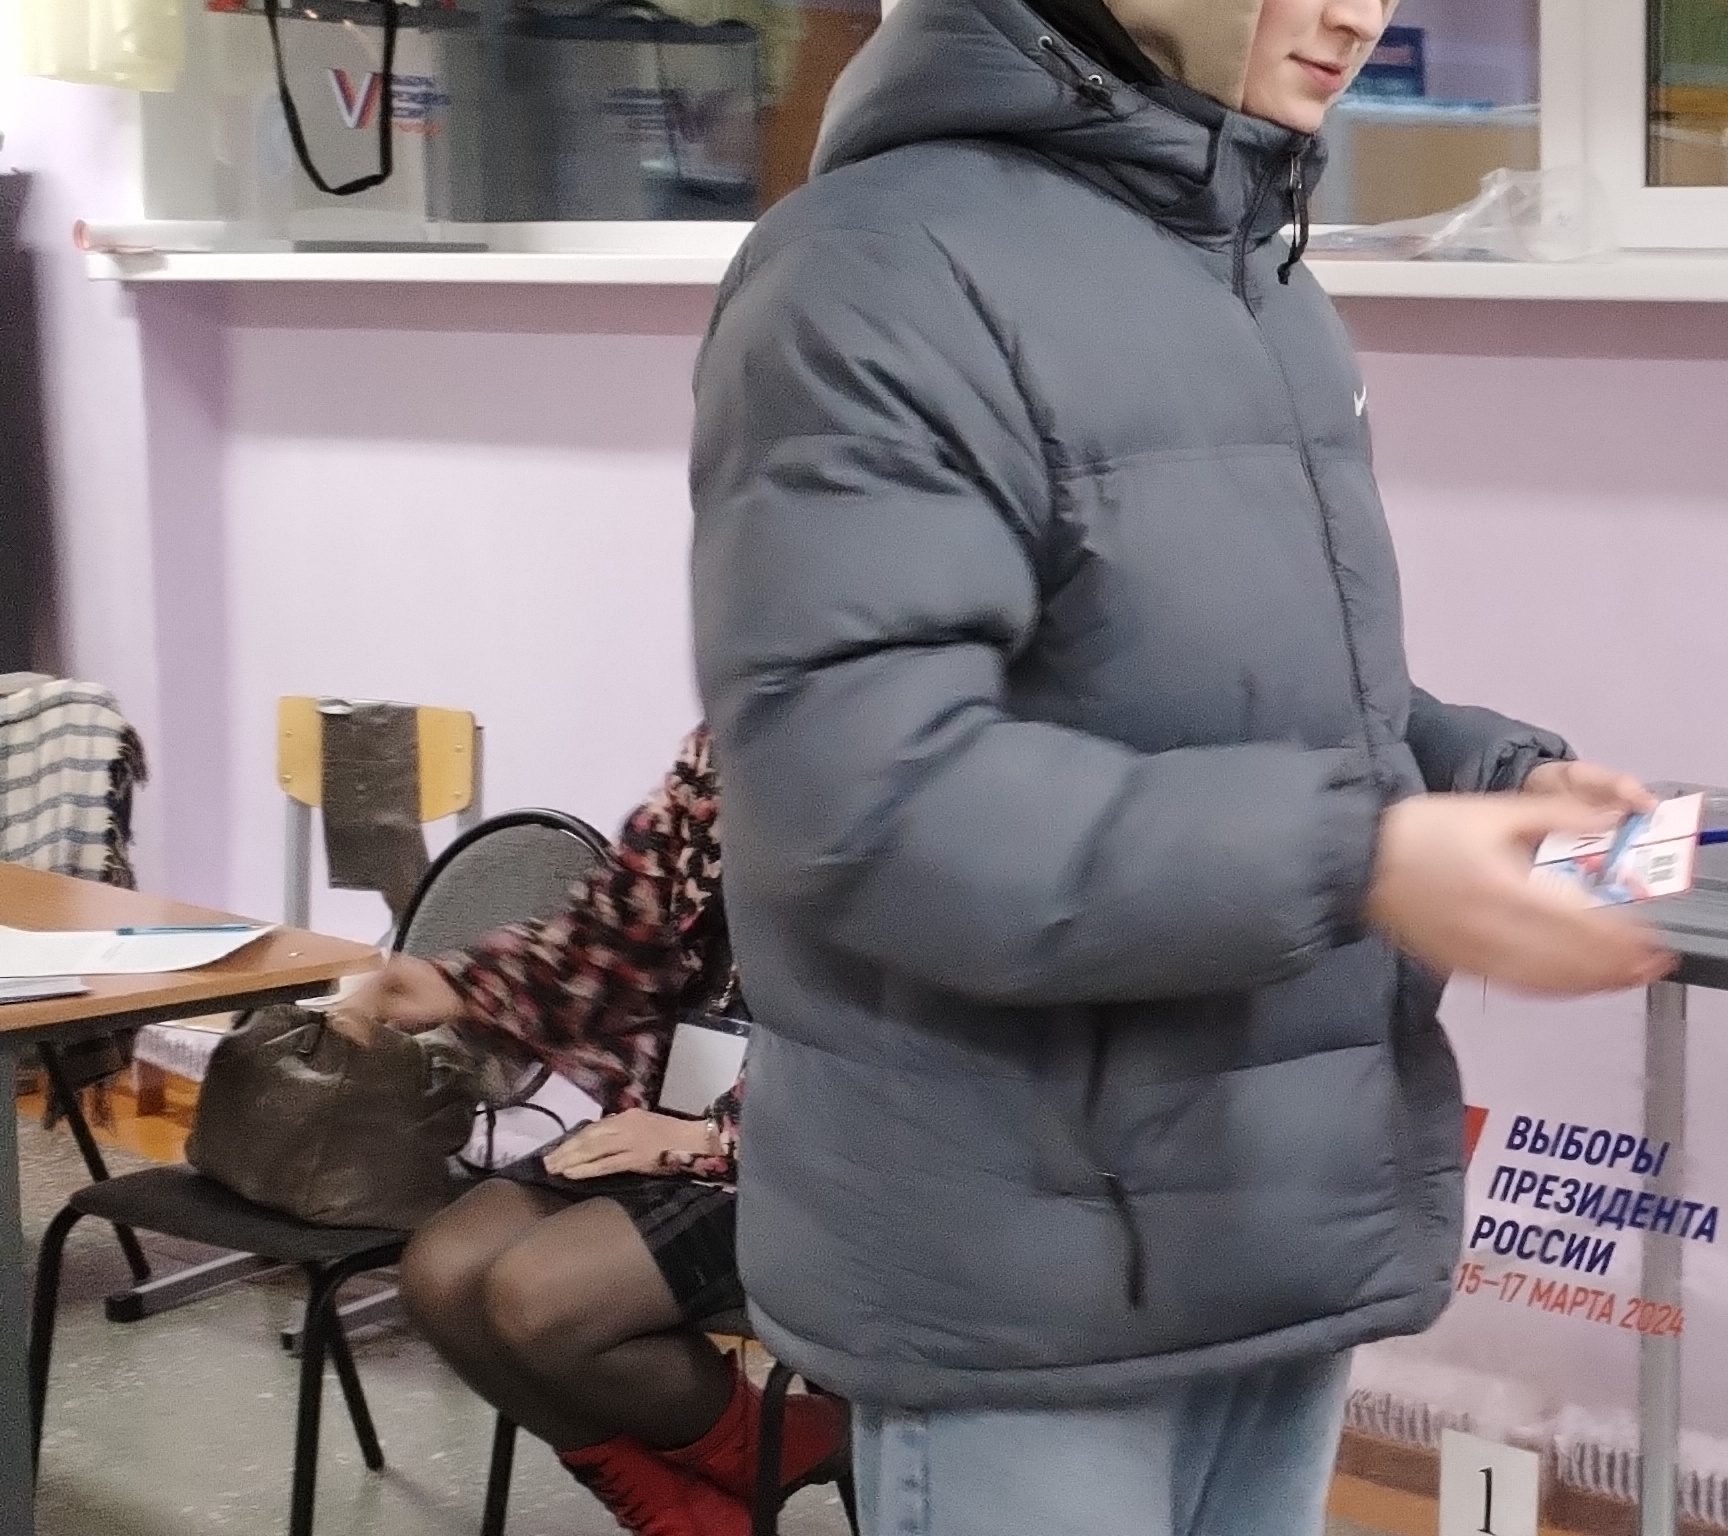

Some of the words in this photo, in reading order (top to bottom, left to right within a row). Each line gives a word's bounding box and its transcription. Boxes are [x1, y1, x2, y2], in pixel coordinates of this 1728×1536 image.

[1505, 1115, 1671, 1177] ВЫБОРЫ
[1488, 1165, 1719, 1243] ПРЕЗИДЕНТА
[1469, 1215, 1617, 1276] РОССИИ
[1527, 1277, 1616, 1325] МАРТА
[1618, 1297, 1685, 1338] 2024
[1477, 1467, 1497, 1536] 1
